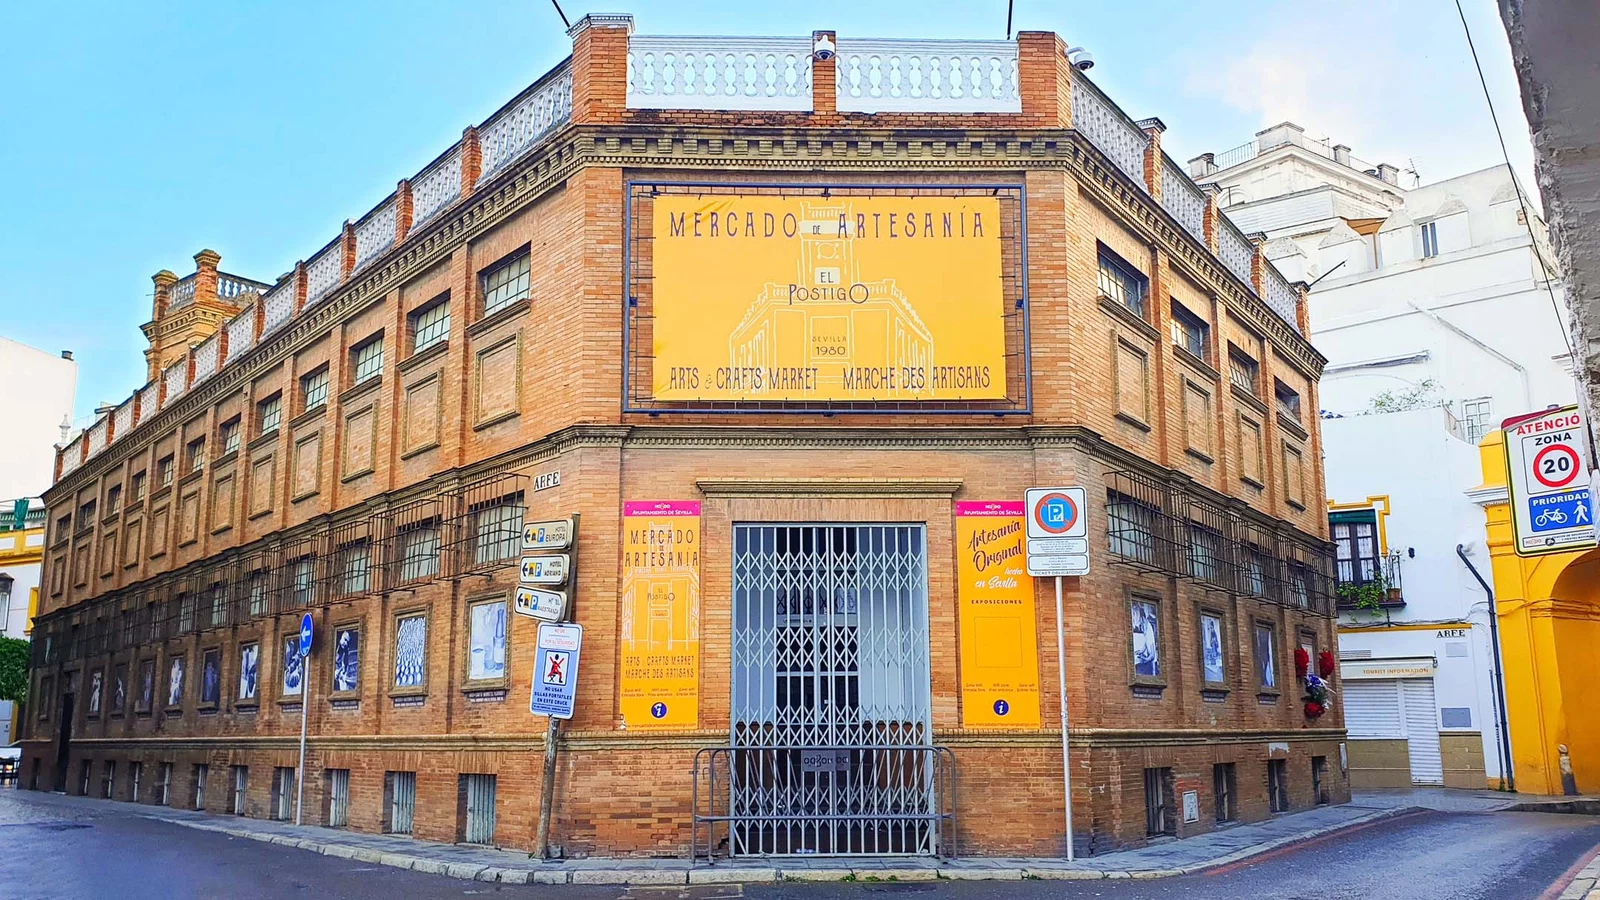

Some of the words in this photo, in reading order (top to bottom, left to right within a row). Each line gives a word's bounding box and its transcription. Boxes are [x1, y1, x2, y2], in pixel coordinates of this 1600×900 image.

[670, 211, 797, 238] MERCADO
[812, 225, 821, 235] DE
[837, 205, 984, 239] ARTESANÍA
[820, 271, 834, 283] EL
[788, 283, 869, 305] POSTIGO
[811, 335, 847, 343] SEVILLA
[815, 346, 847, 356] 1980
[669, 367, 700, 390] ARTS
[715, 367, 763, 390] CRAFTS
[768, 367, 818, 390] MARKET
[842, 366, 896, 390] MARCHE
[902, 366, 925, 389] DES
[932, 366, 991, 389] ARTISANS
[1516, 413, 1580, 435] ATENCIÓ
[1535, 432, 1572, 446] ZONA
[1543, 456, 1570, 474] 20
[534, 471, 559, 490] ARFE
[1532, 492, 1589, 507] PRIORIDAD
[545, 533, 566, 543] EUROPA
[630, 529, 694, 545] MERCADO
[967, 520, 1021, 552] Artesanía
[972, 538, 1024, 572] Original
[974, 580, 986, 588] en
[987, 575, 1017, 589] Sevilla
[1436, 629, 1466, 638] ARFE
[626, 656, 641, 666] ARTS
[647, 655, 669, 666] CRAFTS
[671, 655, 695, 666] MARKET
[625, 668, 650, 679] MARCHE
[652, 668, 664, 679] DES
[666, 667, 695, 678] ARTISANS
